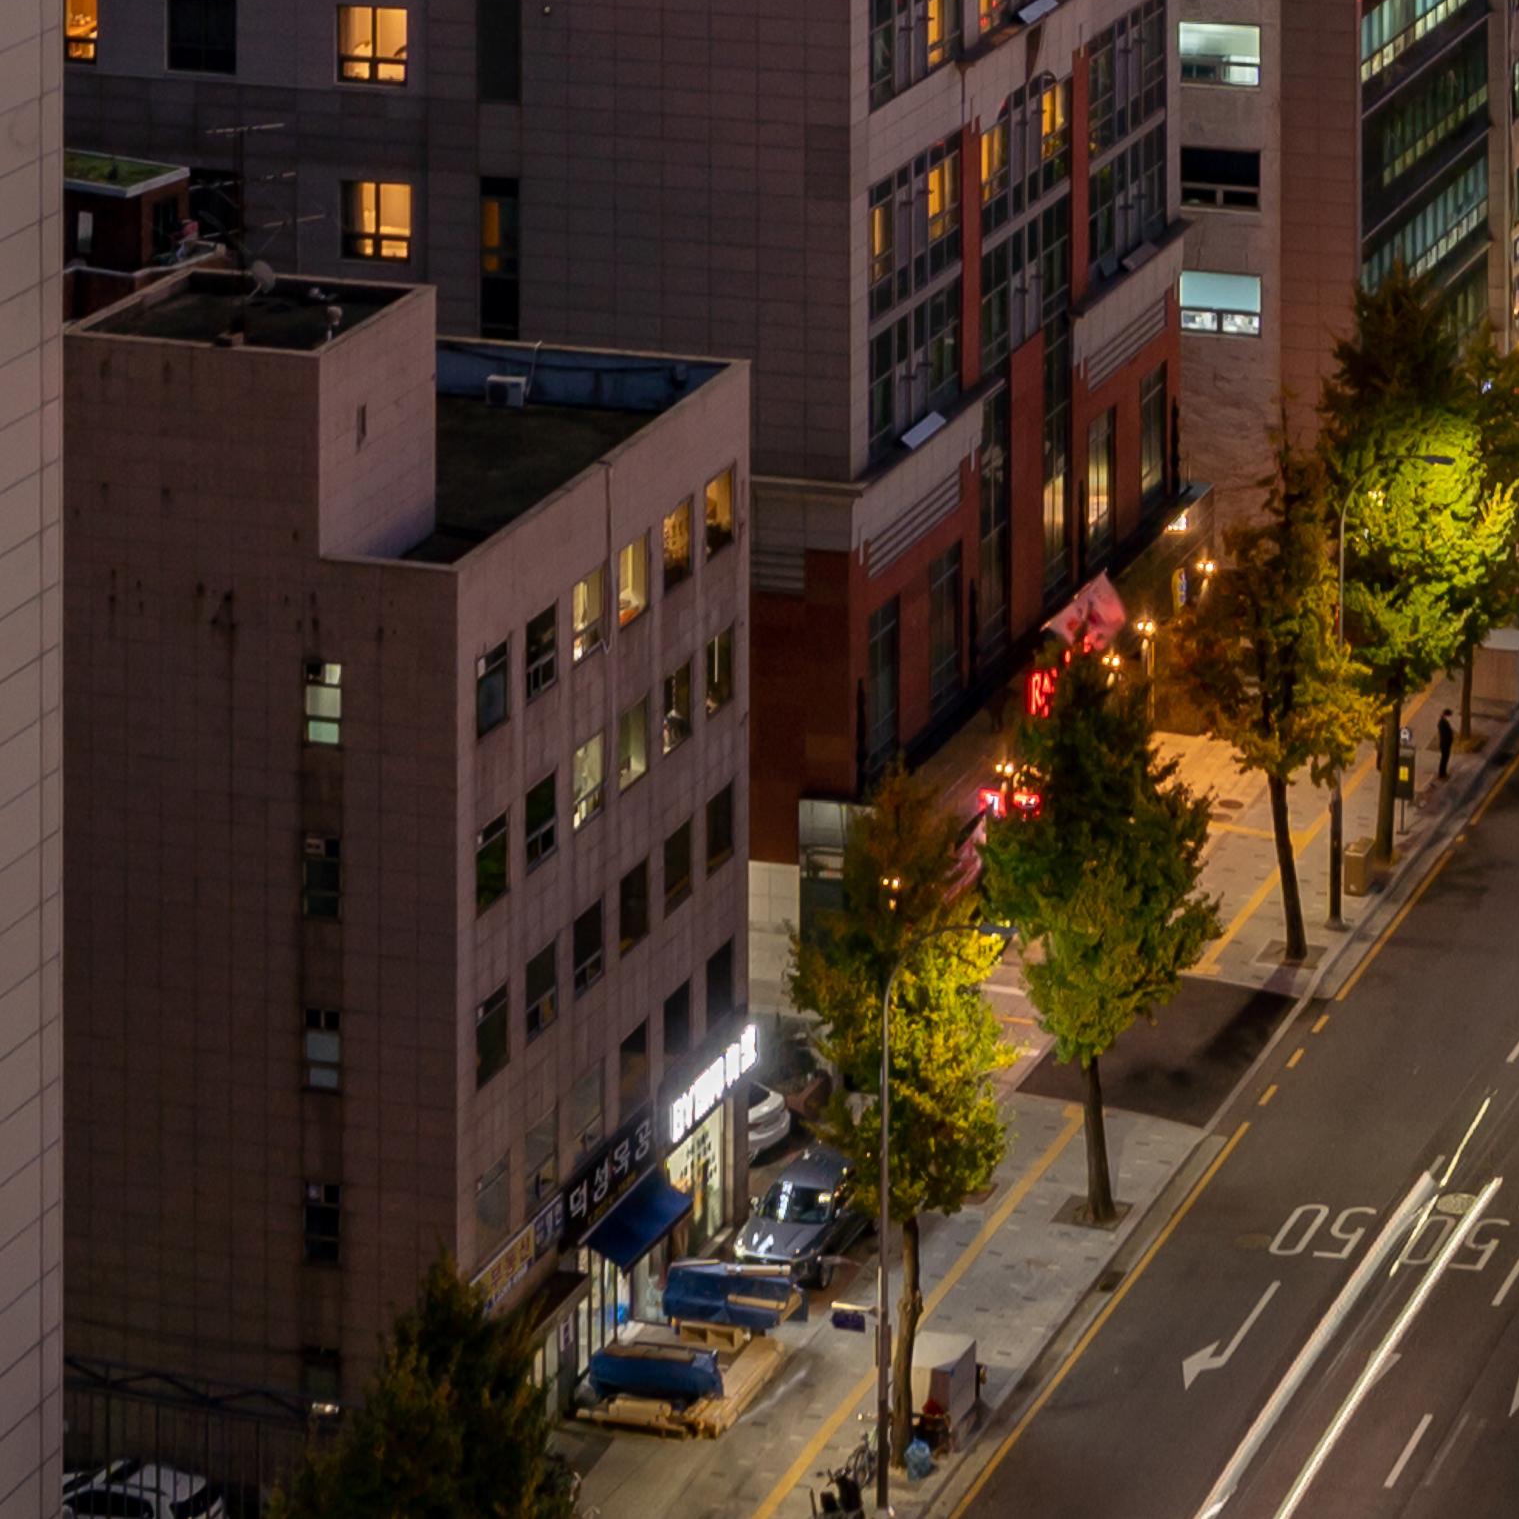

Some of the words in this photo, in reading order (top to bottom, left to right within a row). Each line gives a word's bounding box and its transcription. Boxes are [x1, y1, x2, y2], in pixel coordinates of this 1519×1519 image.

[569, 1116, 653, 1219] 덕성목공
[1269, 1203, 1377, 1259] 50
[1400, 1215, 1511, 1271] 50
